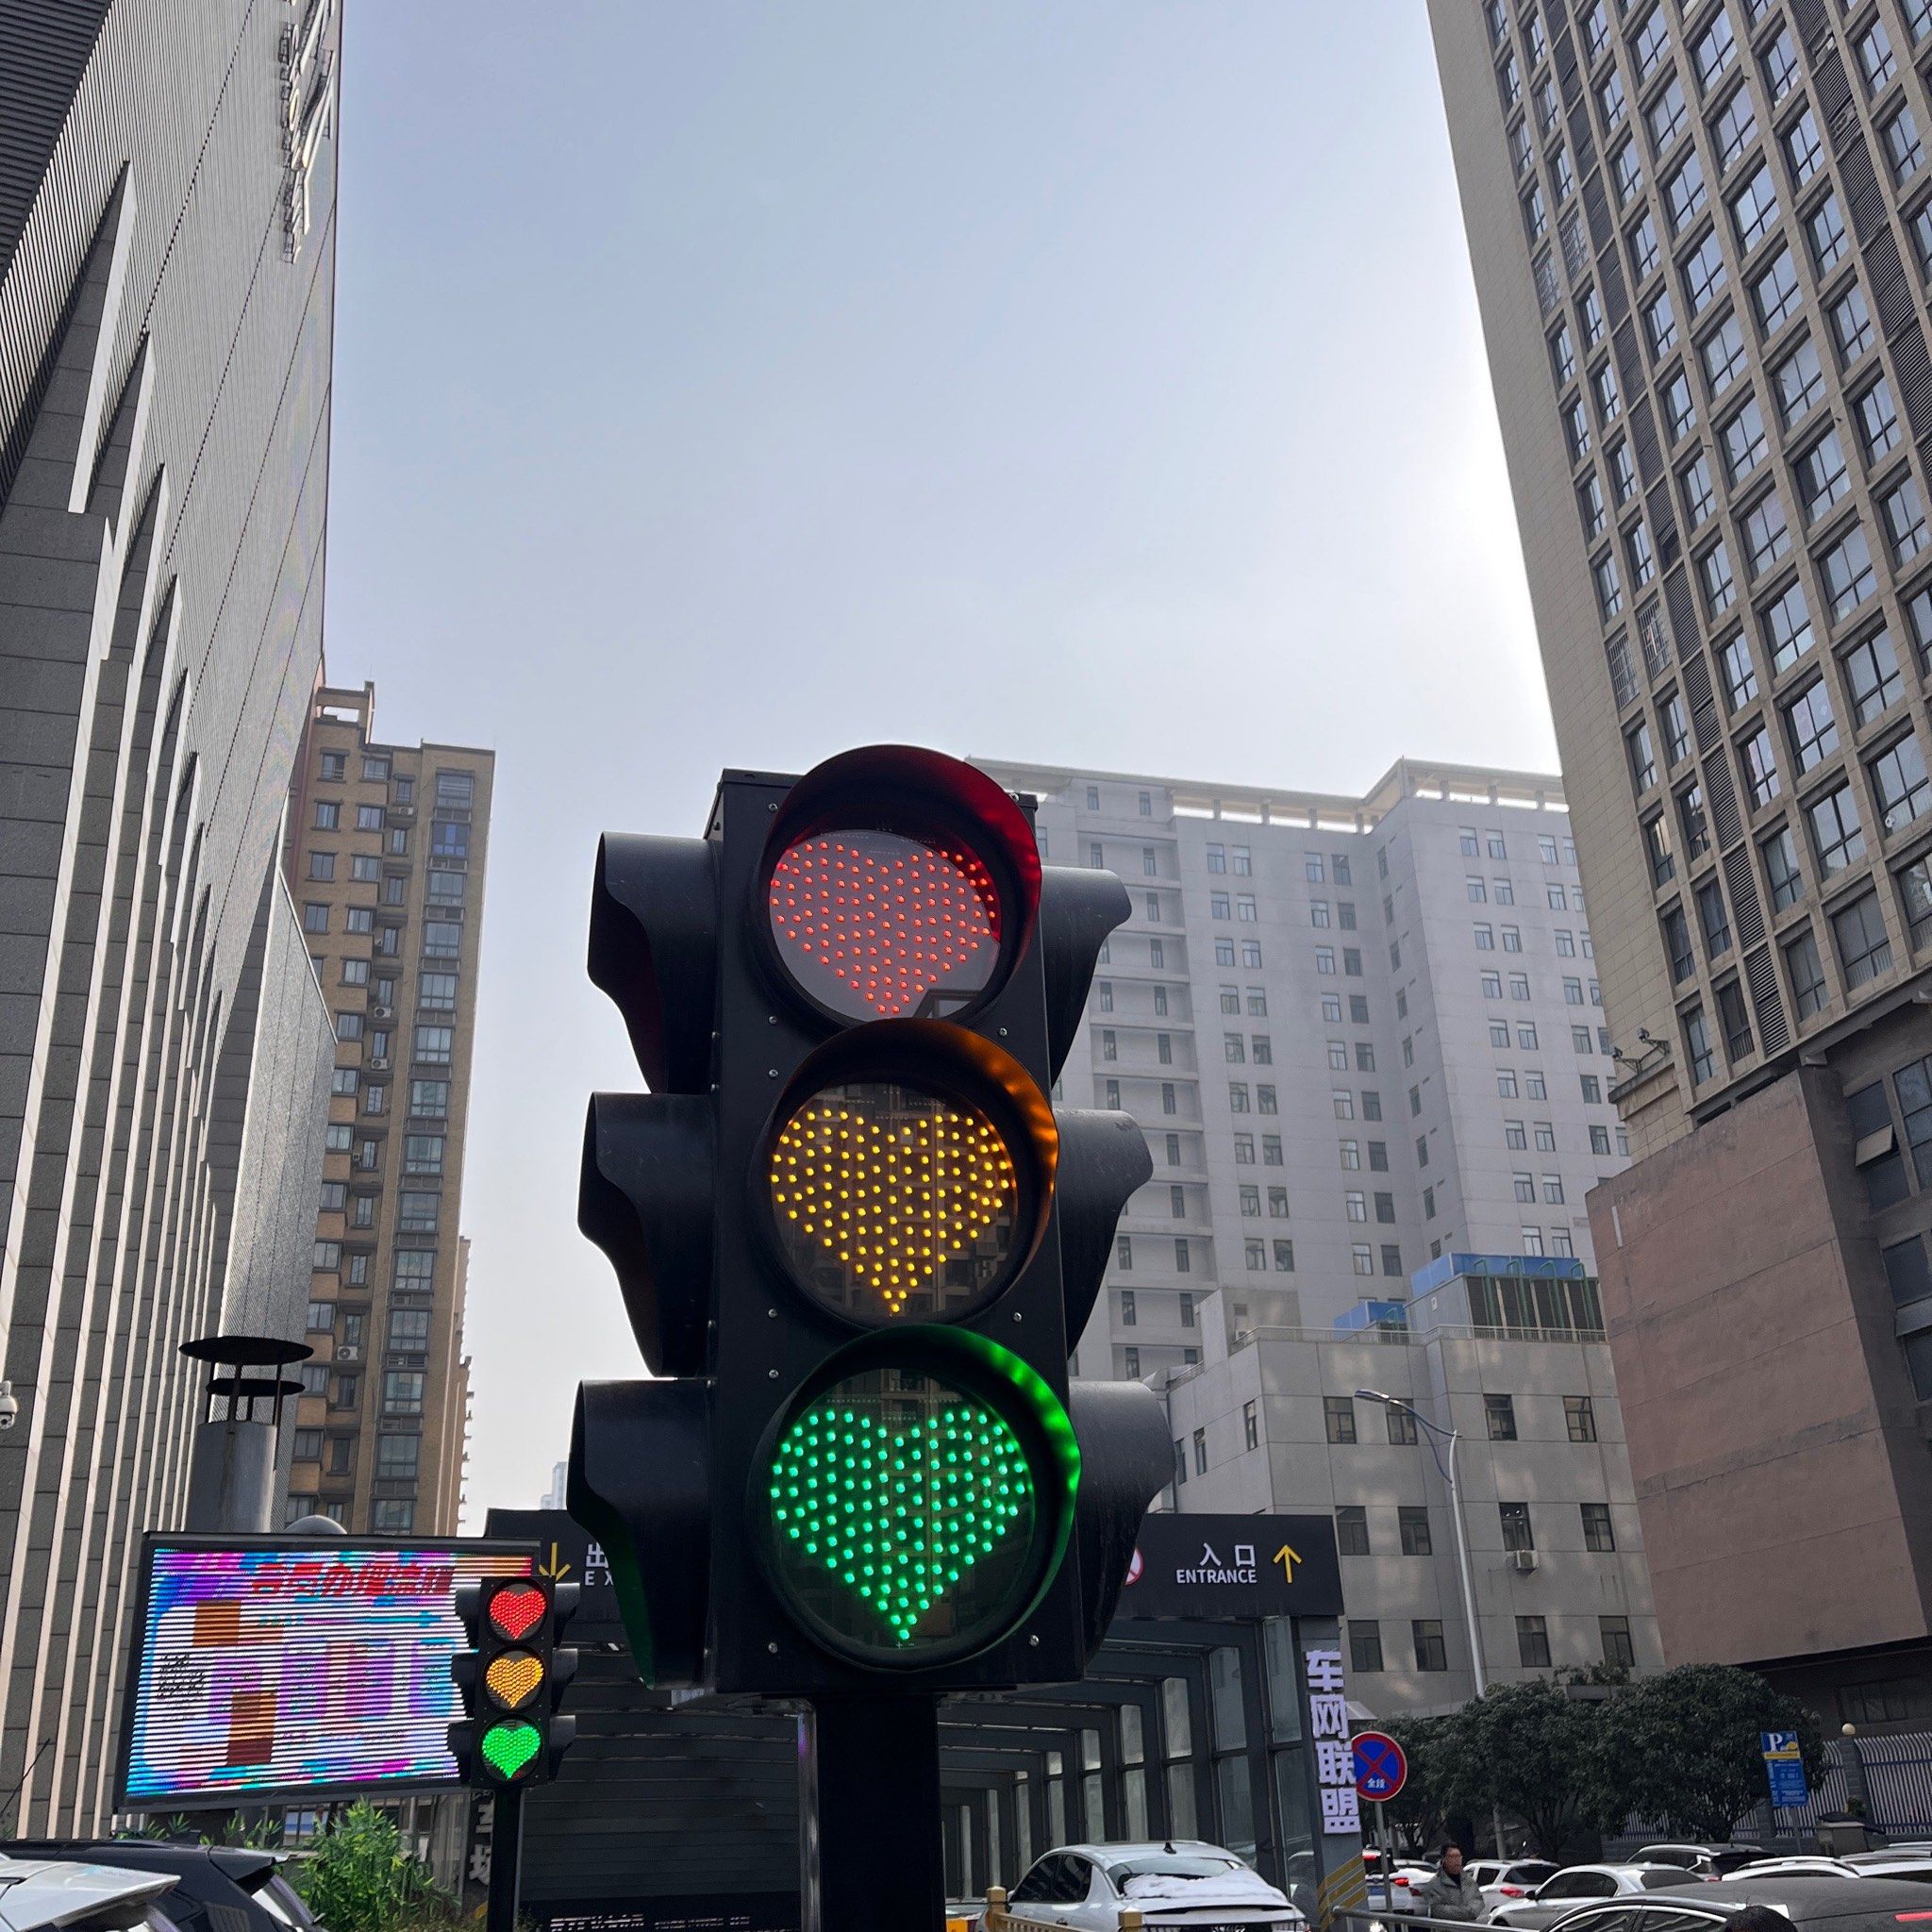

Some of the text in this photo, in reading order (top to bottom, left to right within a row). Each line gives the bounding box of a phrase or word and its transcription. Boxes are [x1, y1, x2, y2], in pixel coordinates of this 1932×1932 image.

[1199, 1542, 1256, 1567] 入口
[1175, 1569, 1257, 1584] ENTRANCE
[1306, 1649, 1361, 1834] 车网联盟
[1769, 1733, 1783, 1752] P
